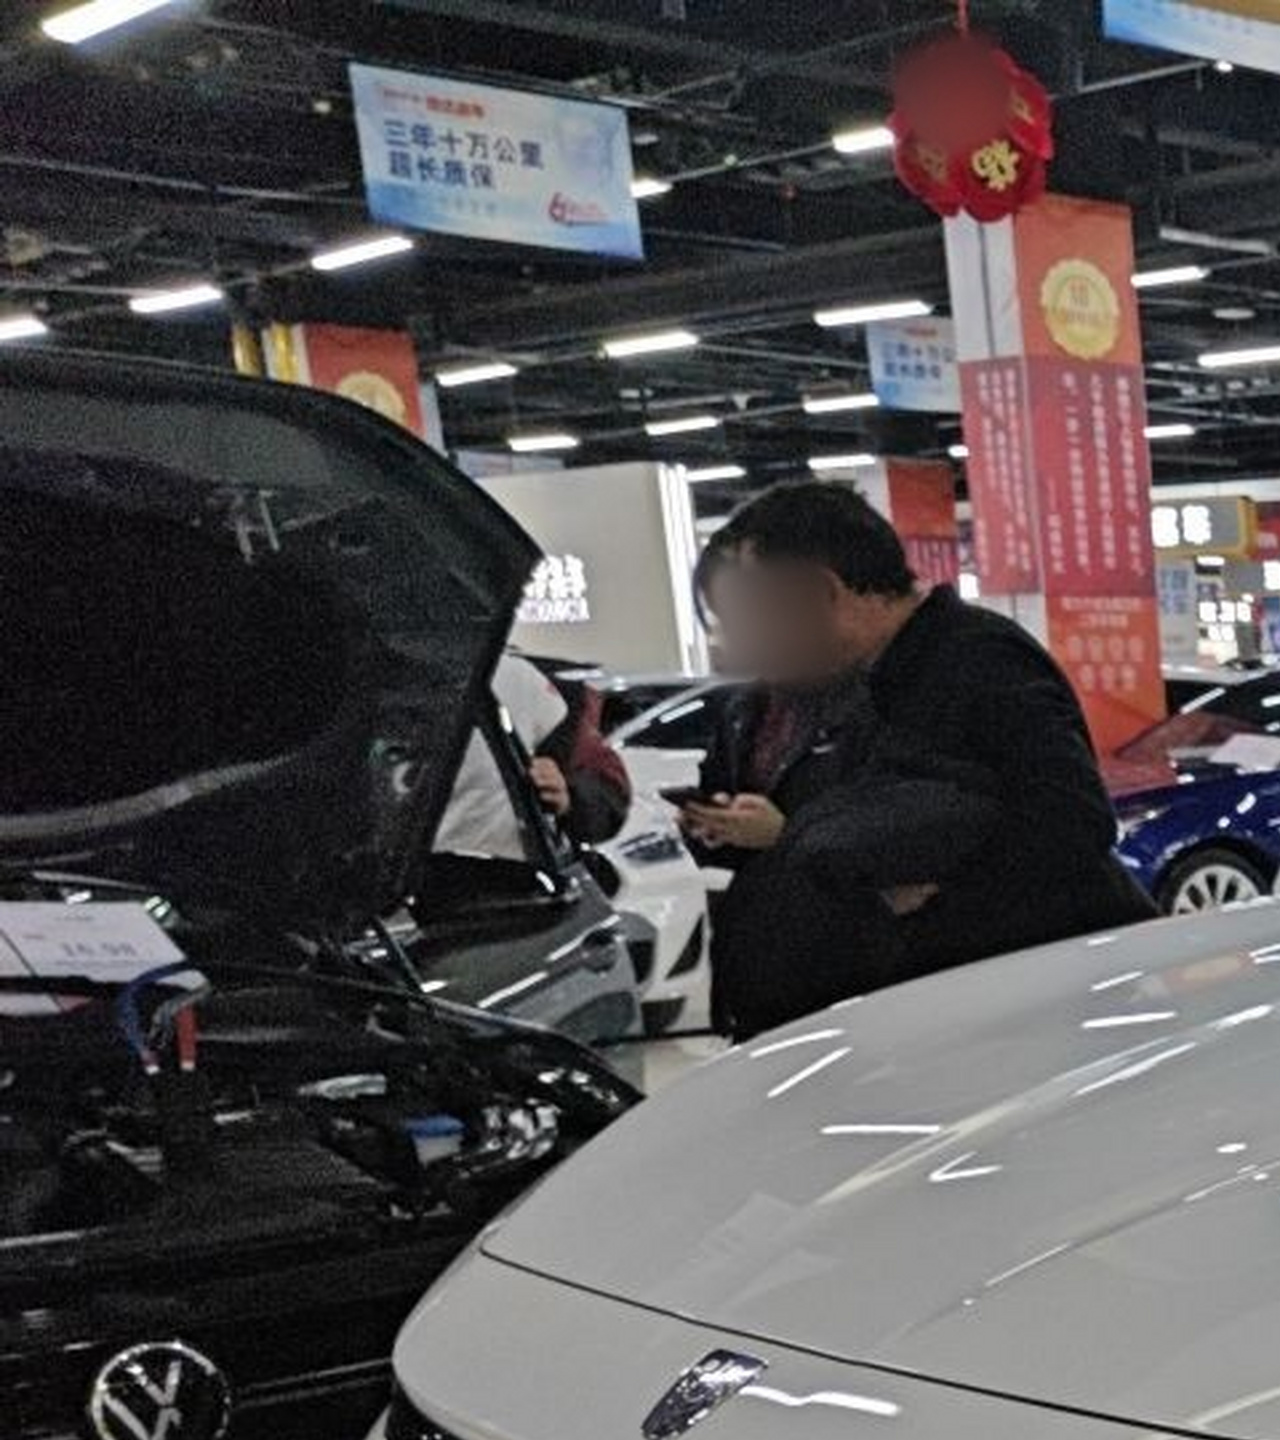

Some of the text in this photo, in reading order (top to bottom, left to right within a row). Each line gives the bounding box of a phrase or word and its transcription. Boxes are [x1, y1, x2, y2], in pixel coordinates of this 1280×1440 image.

[383, 118, 546, 170] 三年十万公里
